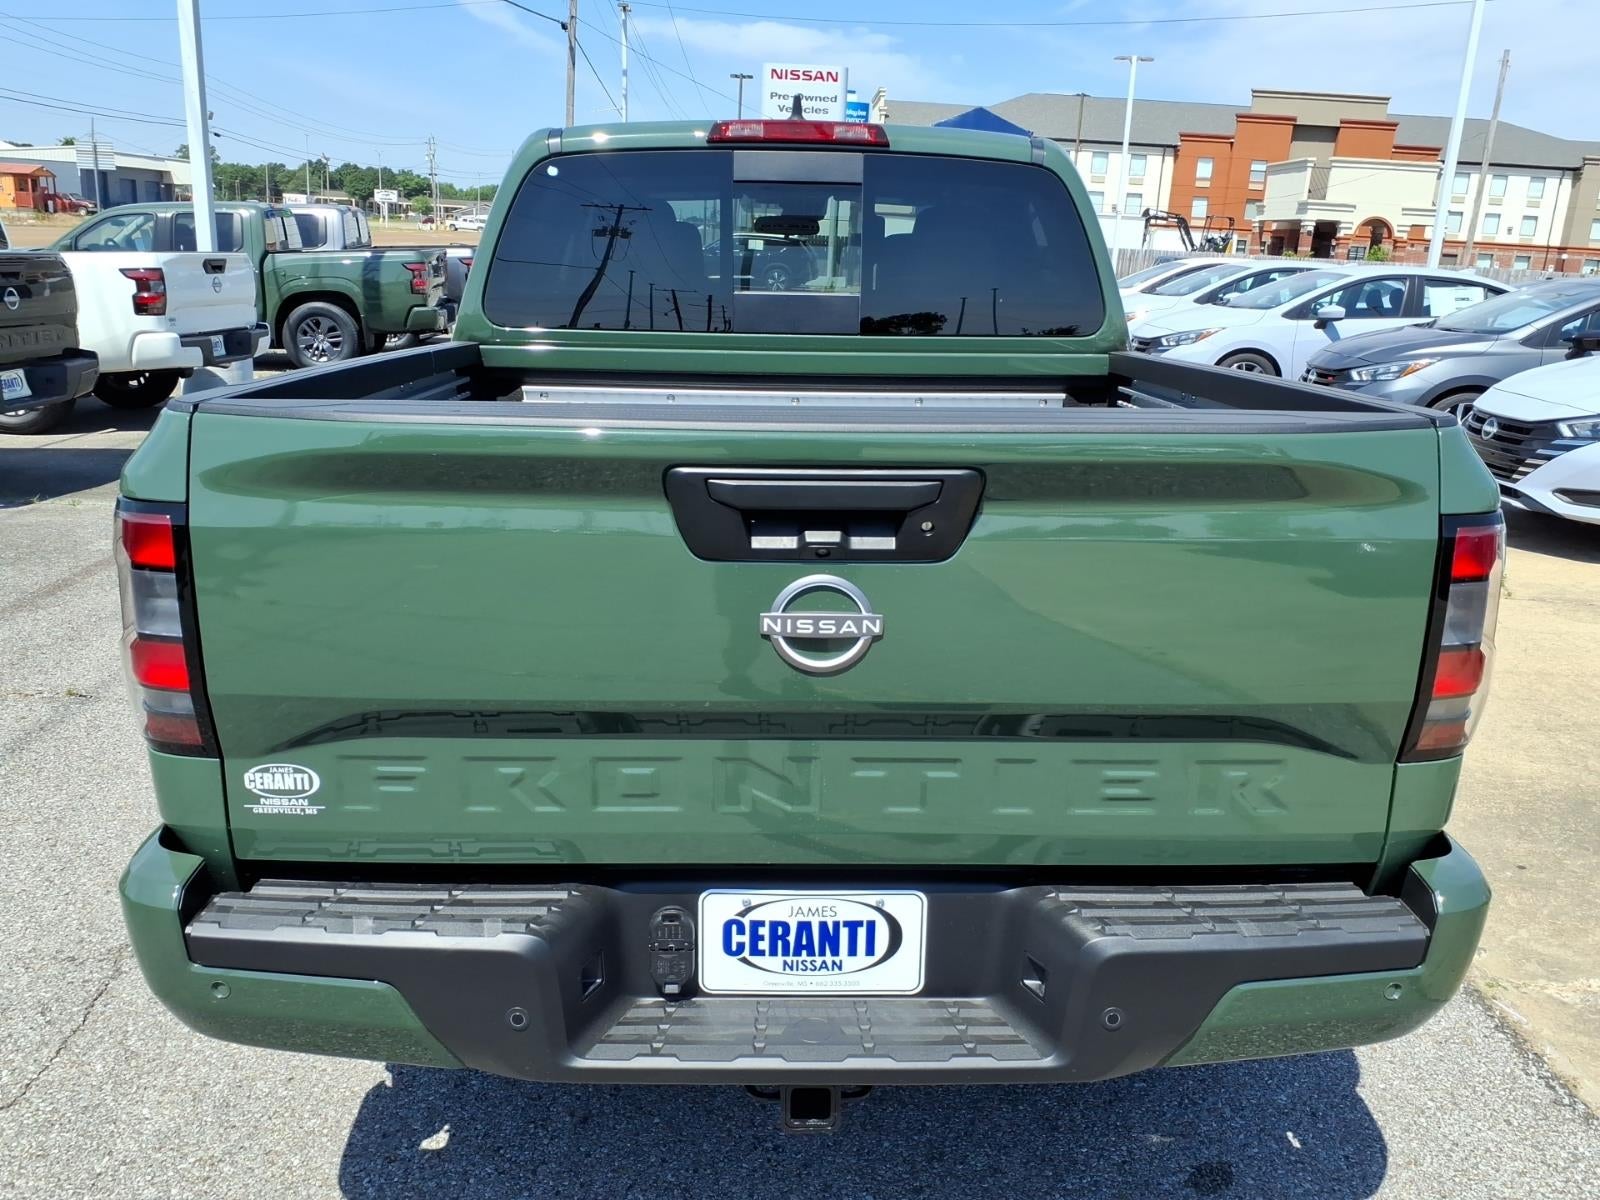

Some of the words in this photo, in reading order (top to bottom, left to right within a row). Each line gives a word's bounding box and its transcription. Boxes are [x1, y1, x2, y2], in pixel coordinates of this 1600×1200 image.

[771, 69, 838, 82] NISSAN
[777, 104, 830, 115] Veicles
[763, 617, 881, 634] NISSAN
[244, 772, 309, 790] CERANTI
[336, 754, 1288, 816] FRONTIER
[260, 798, 309, 806] NISSAN
[788, 906, 838, 918] JAMES
[722, 918, 876, 958] CERANTI
[782, 960, 843, 972] NISSAN
